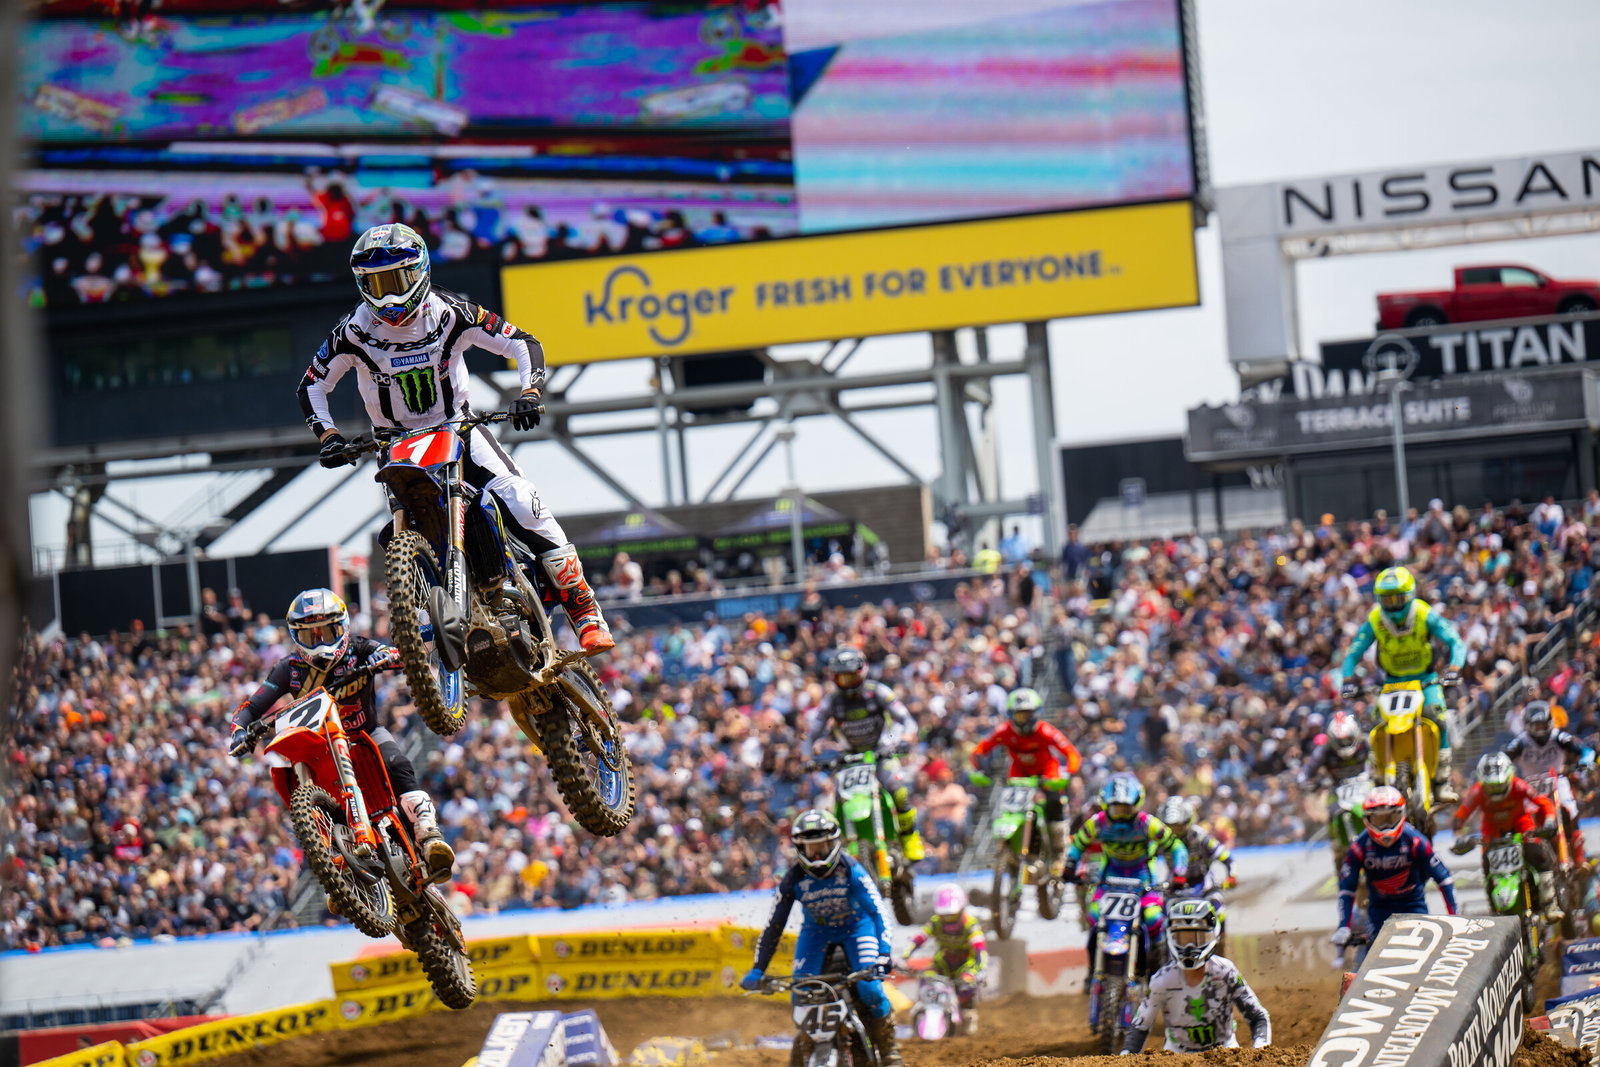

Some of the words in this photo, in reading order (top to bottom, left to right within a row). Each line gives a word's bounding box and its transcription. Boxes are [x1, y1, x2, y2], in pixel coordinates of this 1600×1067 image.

[584, 265, 734, 346] Kroger
[756, 276, 852, 308] FRESH
[864, 267, 926, 300] FOR
[400, 354, 428, 365] YAMAHA
[1430, 320, 1586, 375] TITAN
[1404, 397, 1472, 426] SUITE
[407, 433, 437, 465] 1
[454, 560, 463, 605] DUNLOP
[335, 675, 367, 702] HOR
[1390, 695, 1413, 711] 11
[289, 697, 322, 729] 2
[1105, 896, 1137, 917] 78
[380, 943, 511, 976] DUOP
[581, 936, 695, 957] DUNLOP
[1425, 936, 1490, 987] ROCKY
[375, 974, 530, 1013] DUOP
[575, 969, 712, 991] DUNLOP
[1477, 937, 1524, 1043] MOUNTAIN
[800, 1003, 842, 1035] 46
[169, 1007, 328, 1064] DUNLOP
